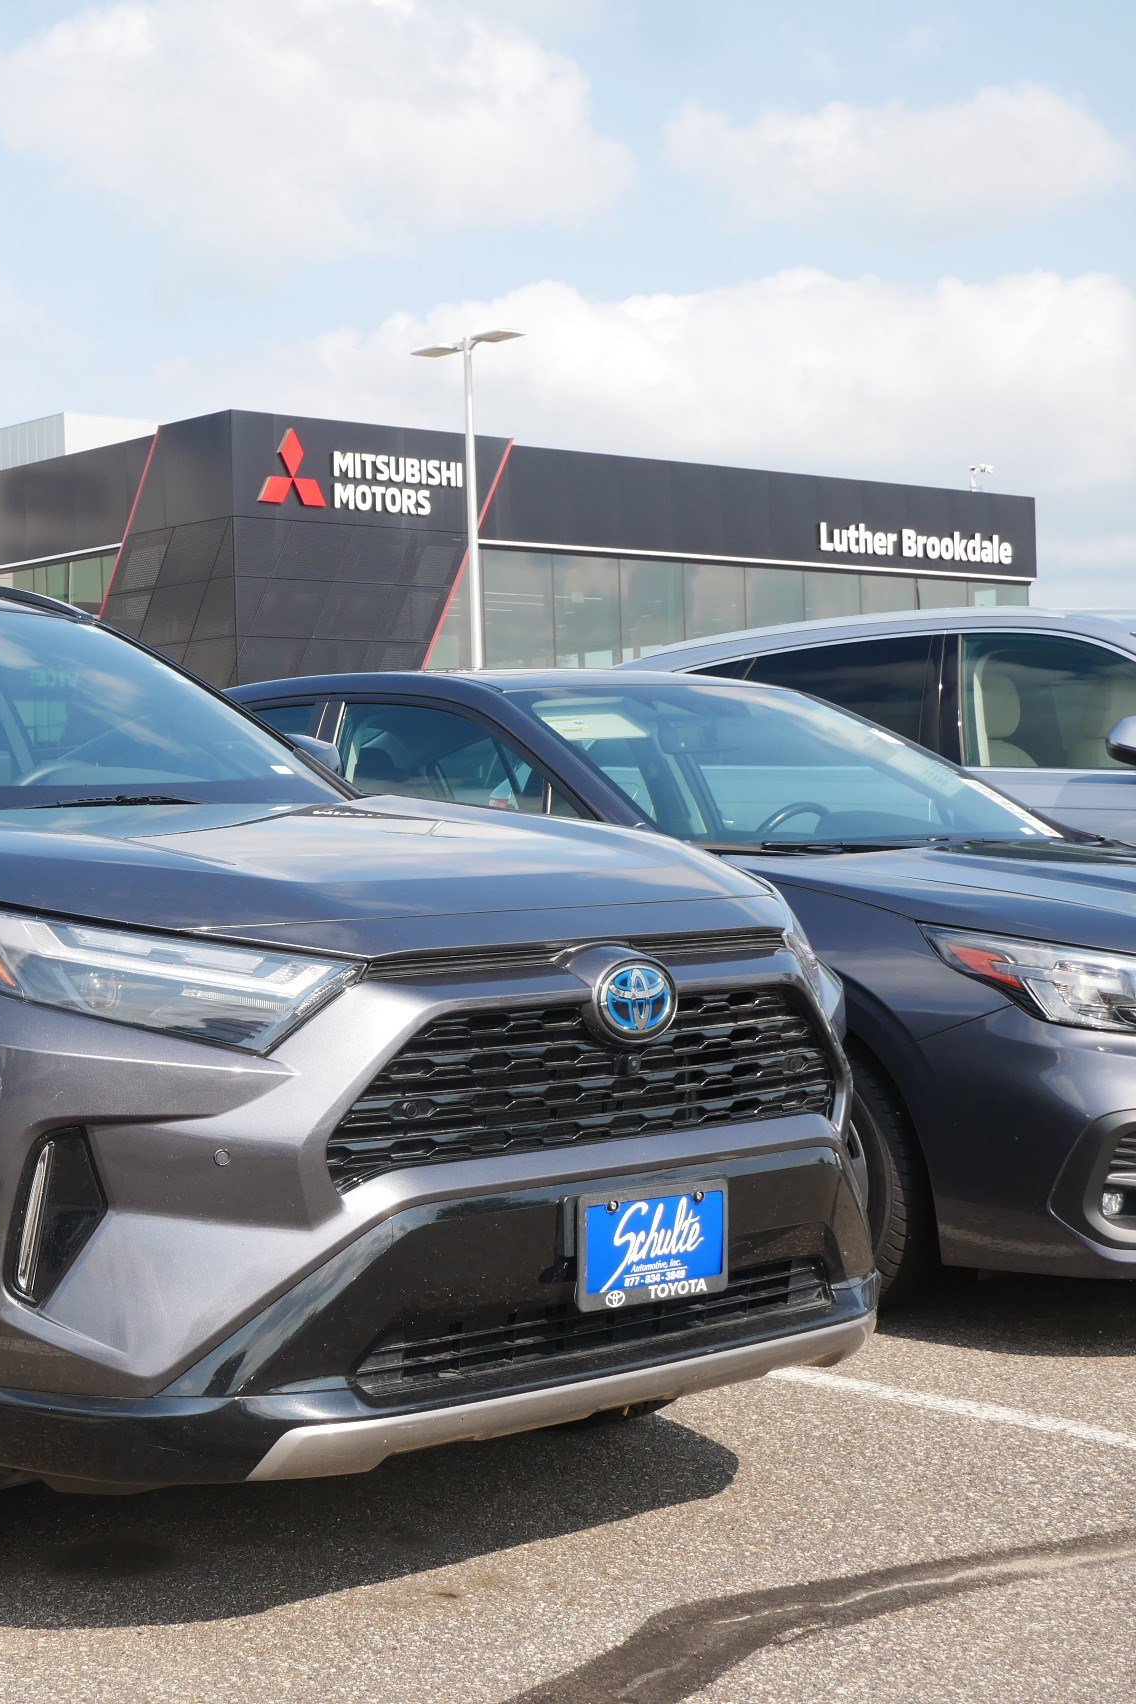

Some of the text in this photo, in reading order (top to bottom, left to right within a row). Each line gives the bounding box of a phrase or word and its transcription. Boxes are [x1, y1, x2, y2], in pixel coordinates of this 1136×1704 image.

[332, 450, 463, 488] MITSUBISHI
[333, 483, 431, 516] MOTORS
[819, 521, 1013, 565] Luther Brookdale
[599, 1196, 704, 1294] Schulte
[648, 1277, 708, 1299] TOYOTA
